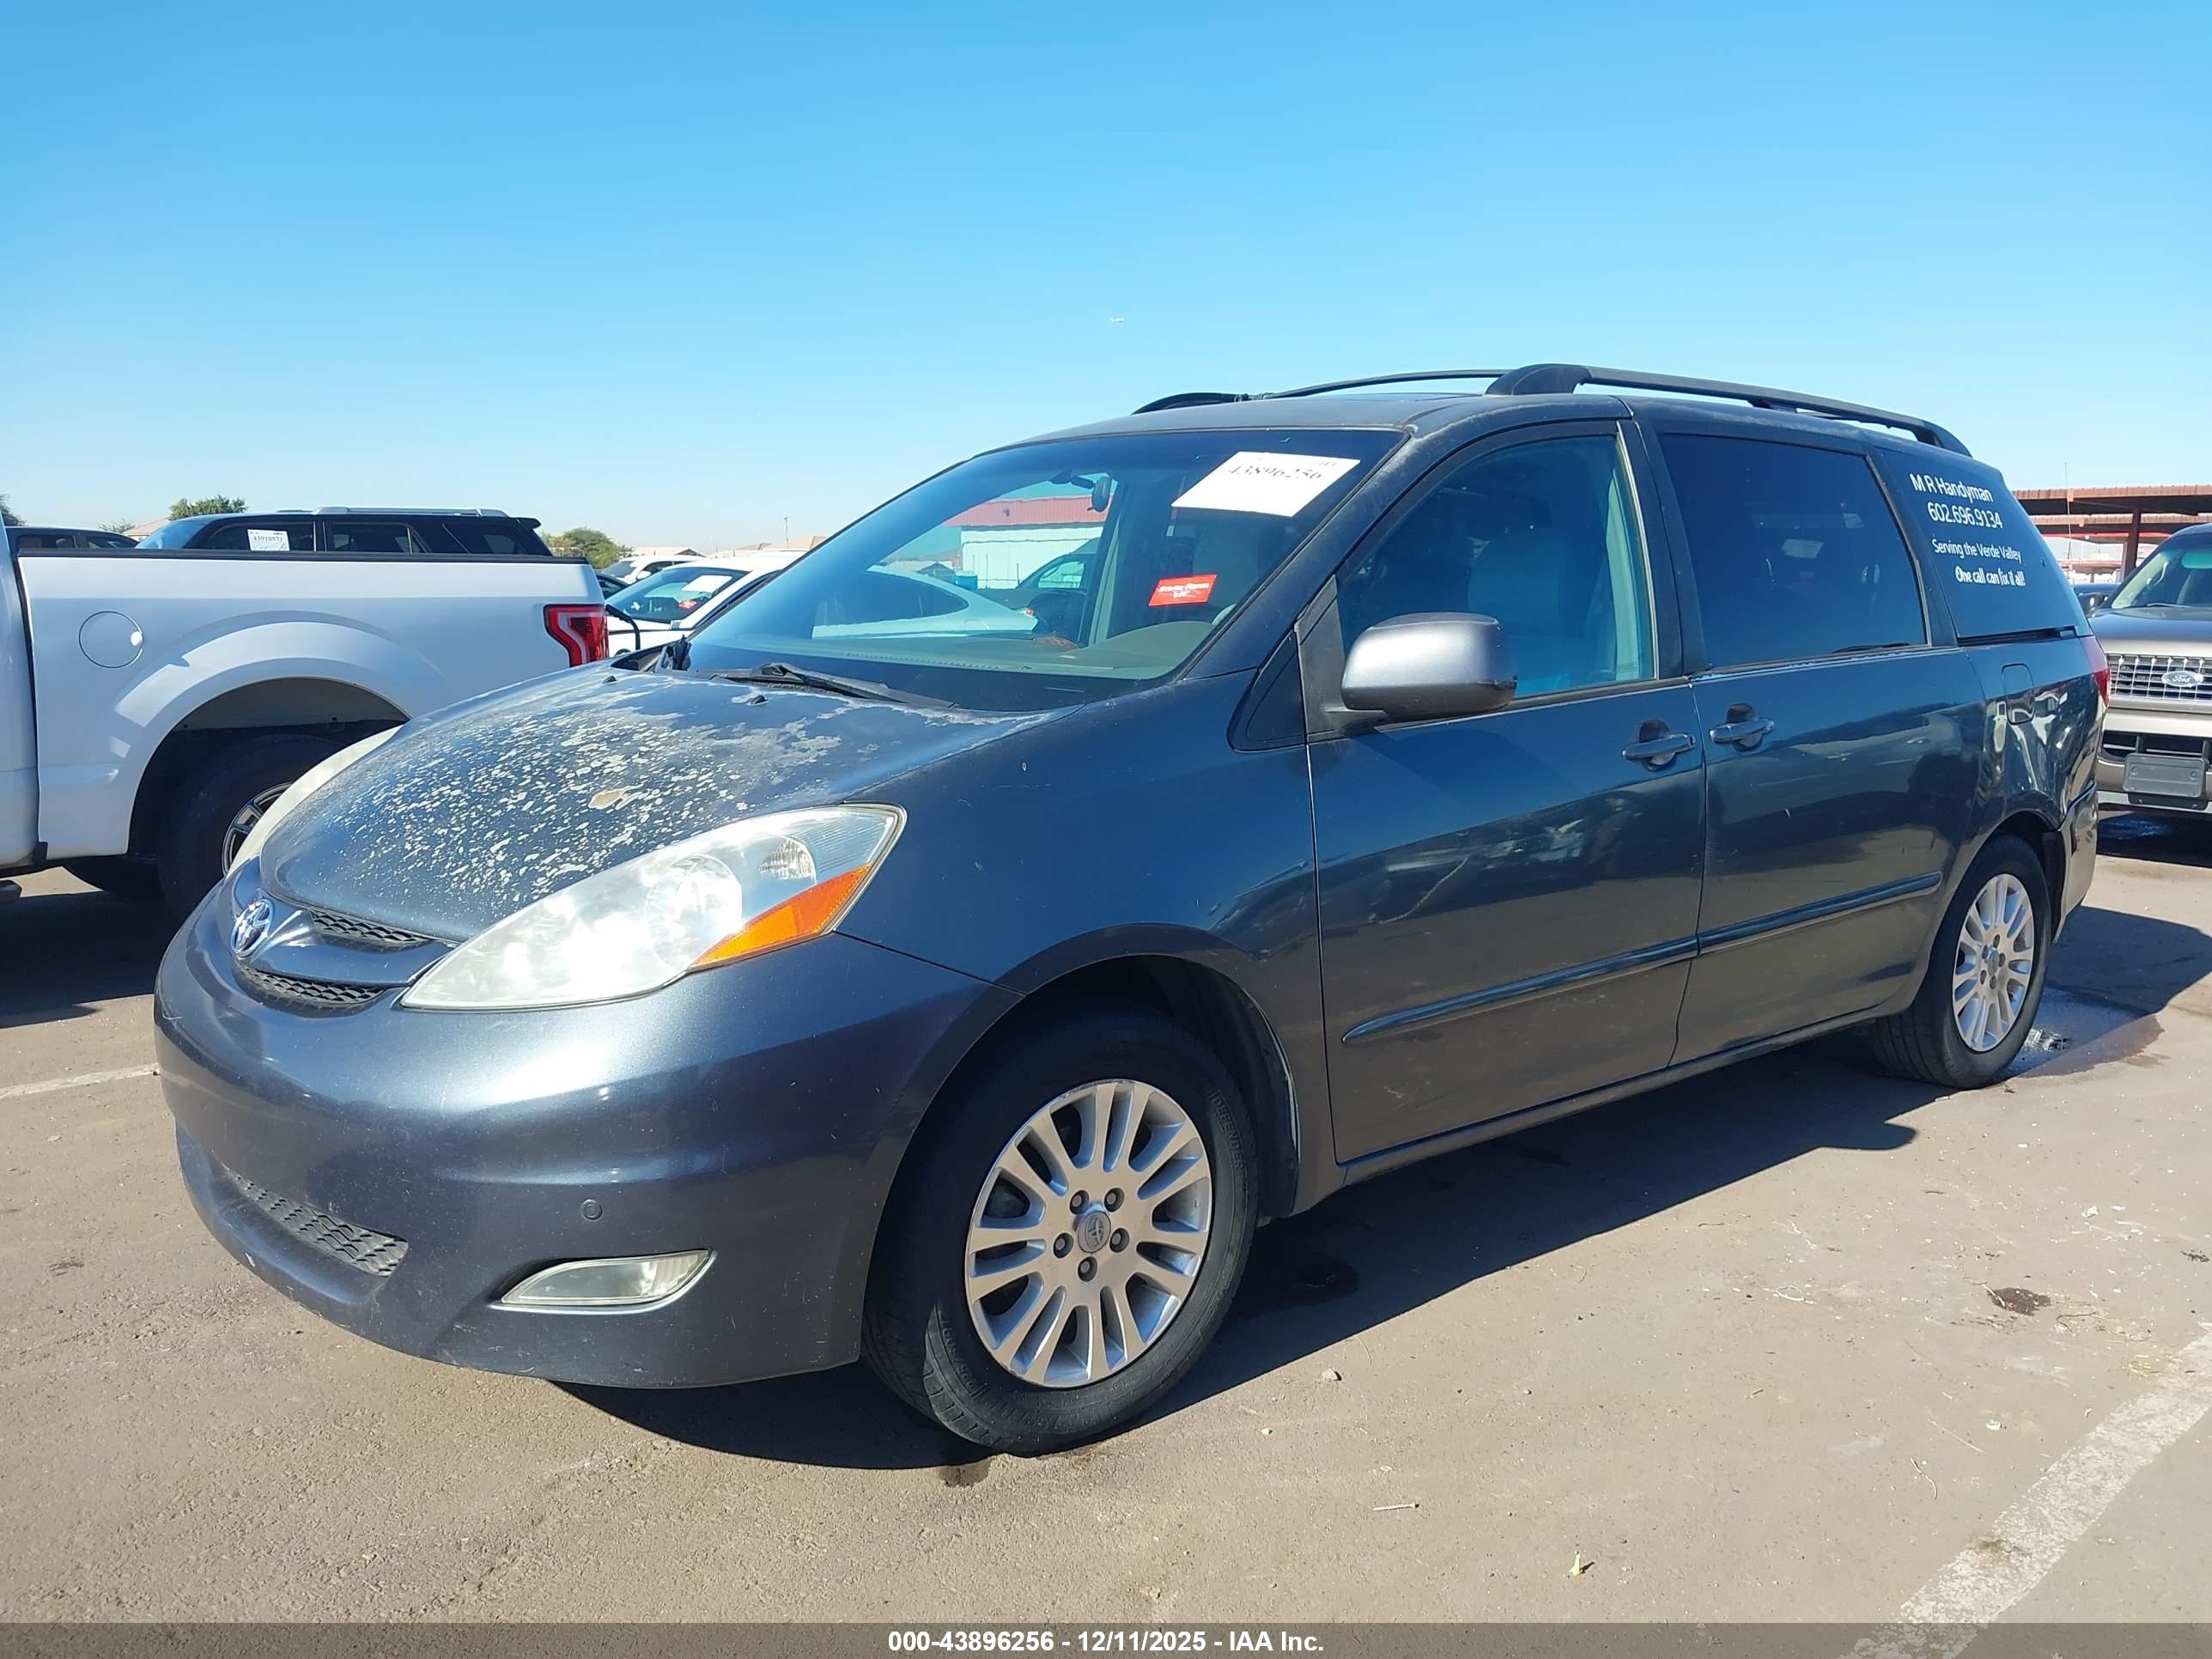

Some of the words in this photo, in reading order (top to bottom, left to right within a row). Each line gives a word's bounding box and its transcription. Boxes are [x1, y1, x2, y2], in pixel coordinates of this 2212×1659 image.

[1910, 473, 1926, 492] M
[1923, 474, 1937, 493] R
[1934, 476, 1994, 504] Handyman
[1927, 501, 2003, 529] 602.696.9134
[1932, 538, 1964, 559] Serving
[1963, 542, 1978, 556] the
[1976, 543, 2000, 558] Verde
[1999, 545, 2021, 564] Valley
[1955, 566, 1972, 582] One
[1972, 567, 1986, 584] call
[1986, 572, 2000, 584] can
[1997, 567, 2009, 586] fix
[2008, 570, 2015, 586] it
[2014, 570, 2027, 586] all!
[1212, 1097, 1244, 1169] DEFENDER
